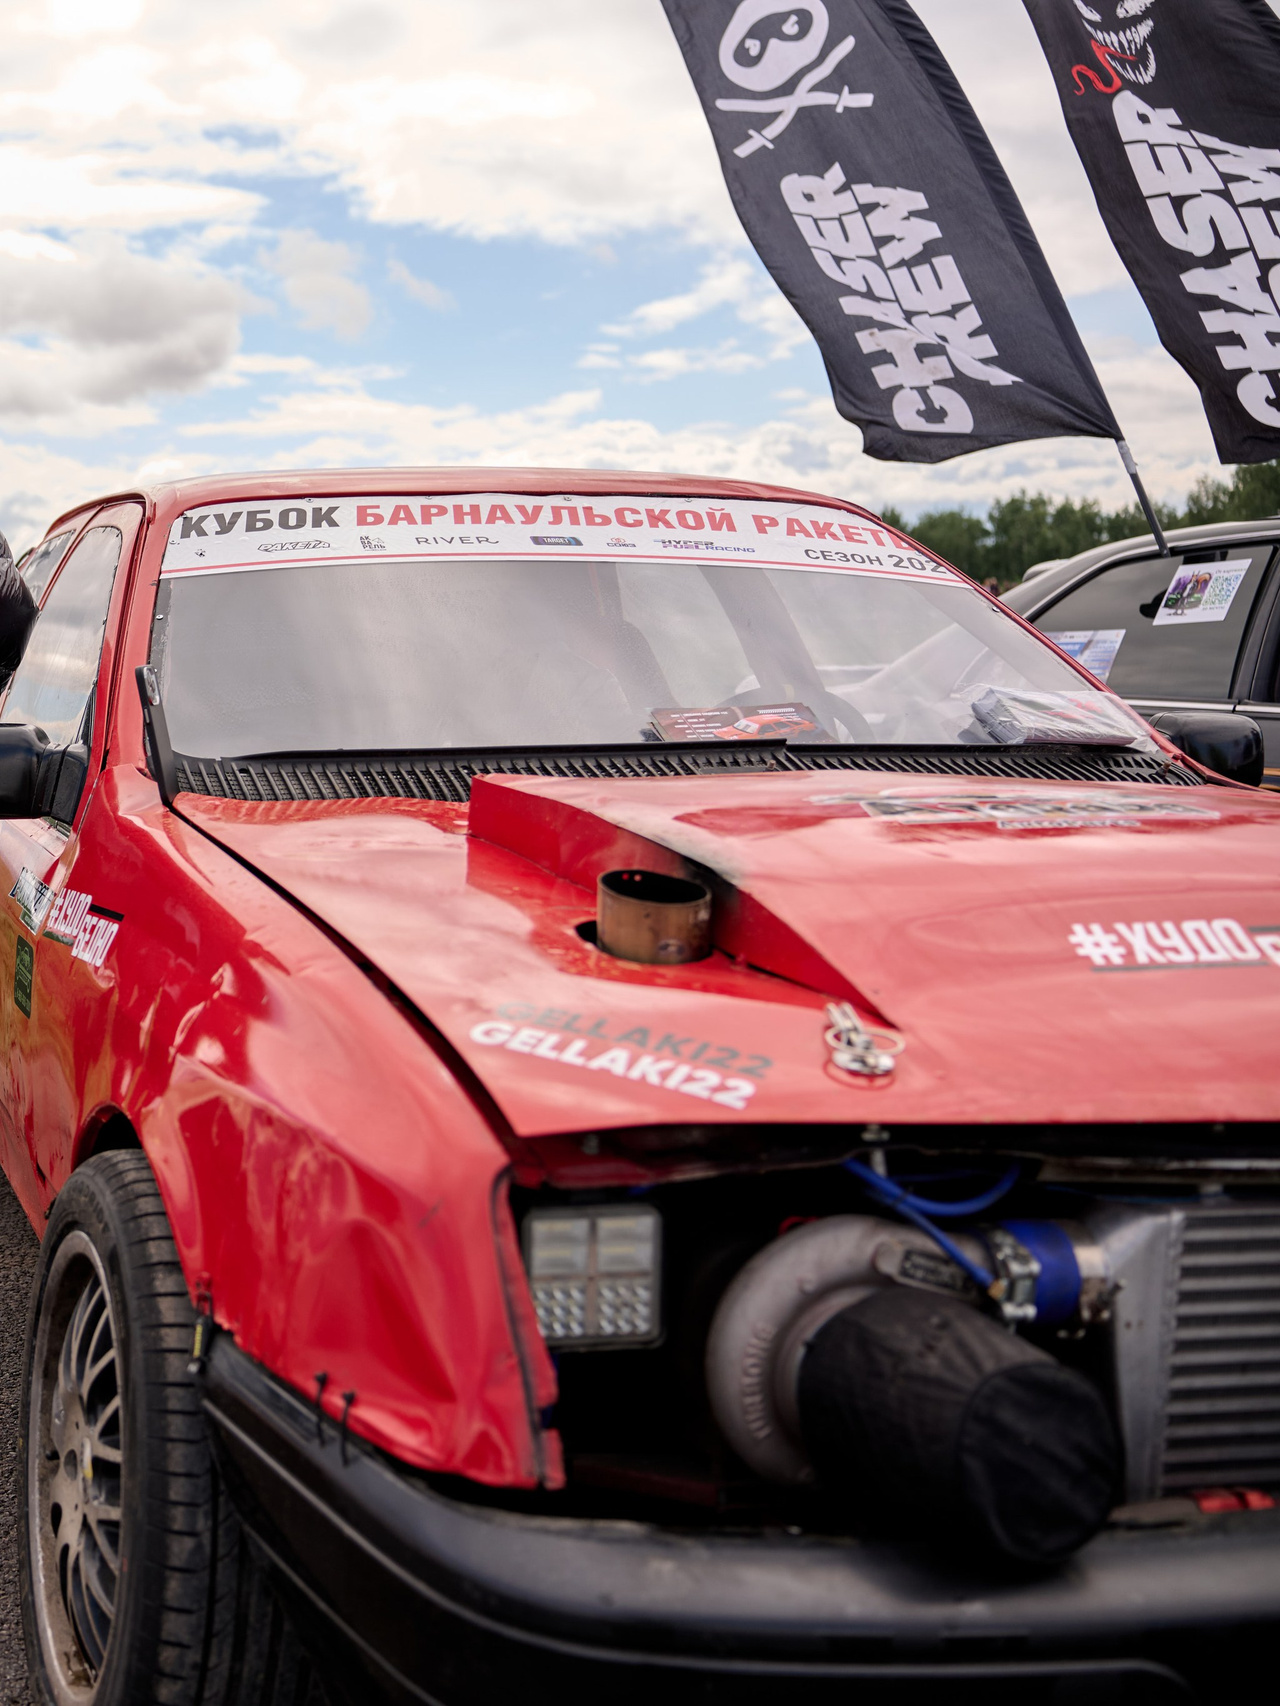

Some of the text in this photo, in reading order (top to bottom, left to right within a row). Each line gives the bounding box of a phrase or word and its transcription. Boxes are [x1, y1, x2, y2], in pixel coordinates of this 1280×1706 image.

[780, 162, 974, 433] CHASER
[180, 505, 340, 540] КУБОК
[356, 504, 738, 533] БАРНАУЛЬСКОЙ
[257, 539, 331, 552] РАКЕТА
[415, 536, 499, 546] RIVER
[804, 548, 884, 567] СЕЗОН
[1068, 917, 1262, 966] #ХУДО
[470, 1020, 755, 1111] GELLAKI22
